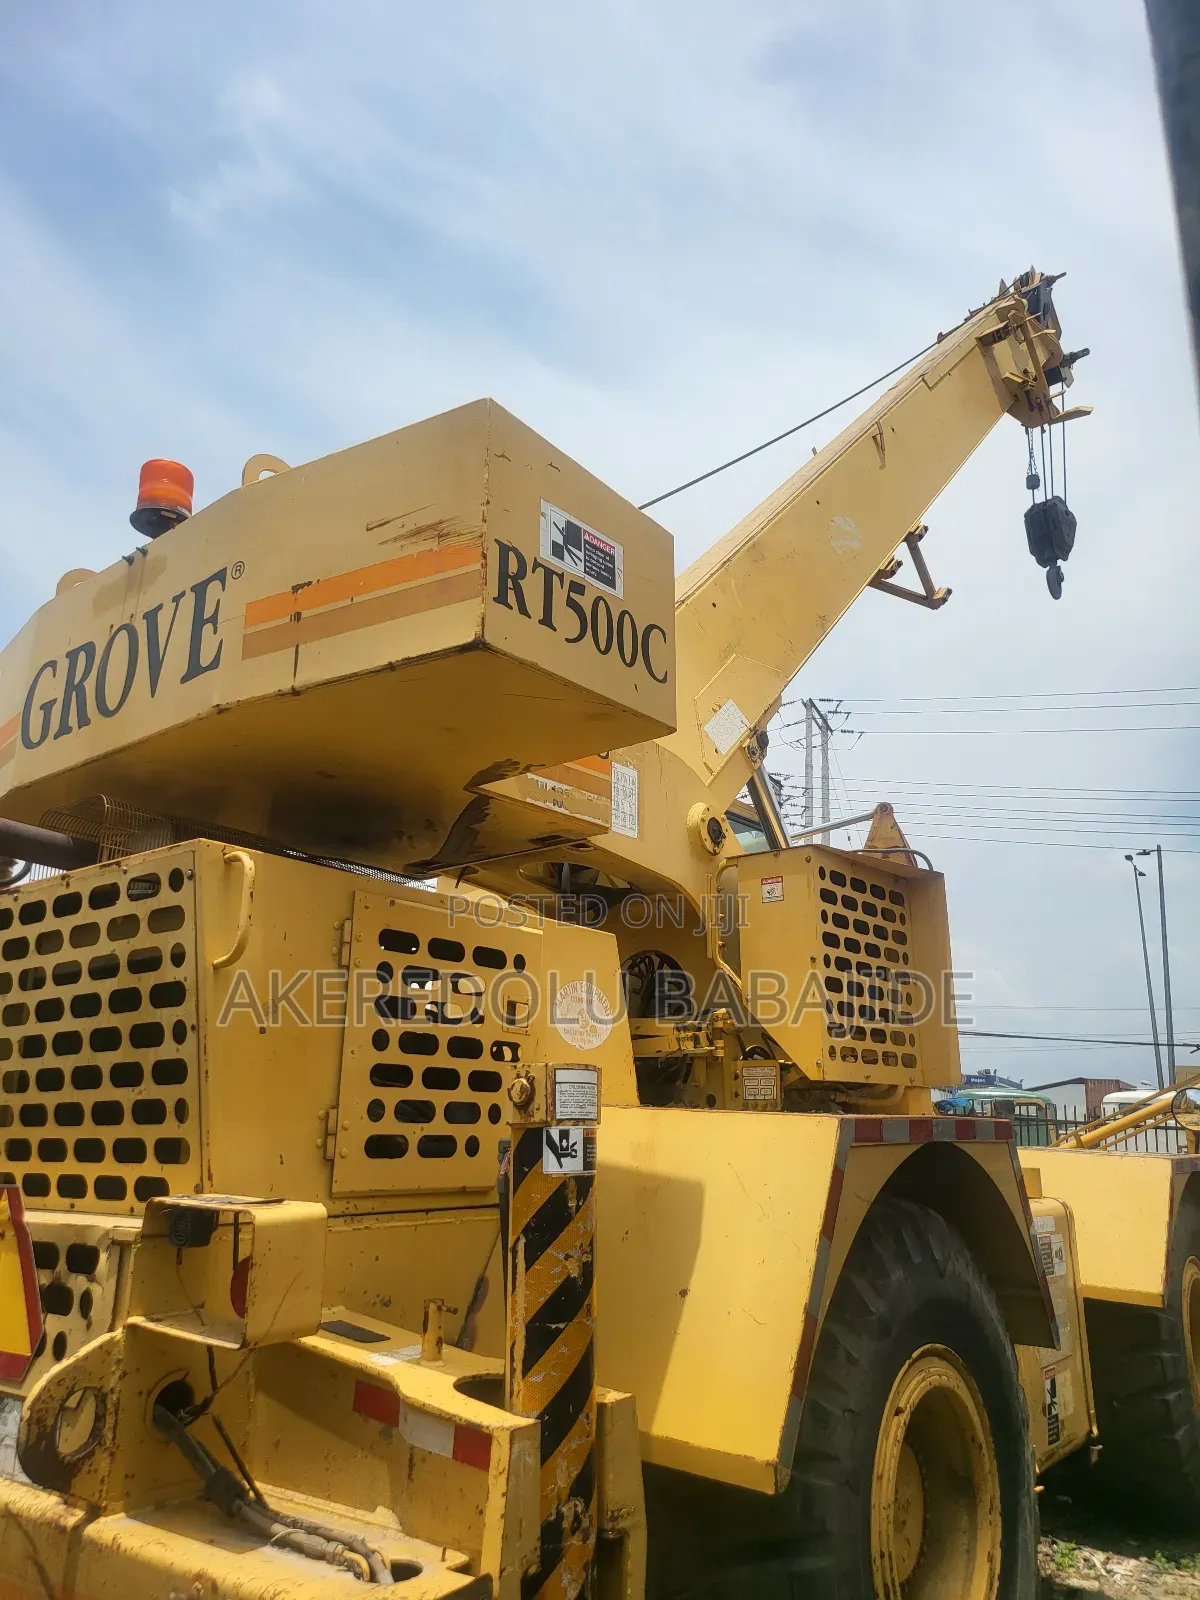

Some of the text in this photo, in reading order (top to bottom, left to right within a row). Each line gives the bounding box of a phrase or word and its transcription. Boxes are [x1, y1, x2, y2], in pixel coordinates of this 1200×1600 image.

[493, 538, 668, 684] RT500C
[589, 534, 616, 556] DANGER
[21, 567, 228, 750] GROVE
